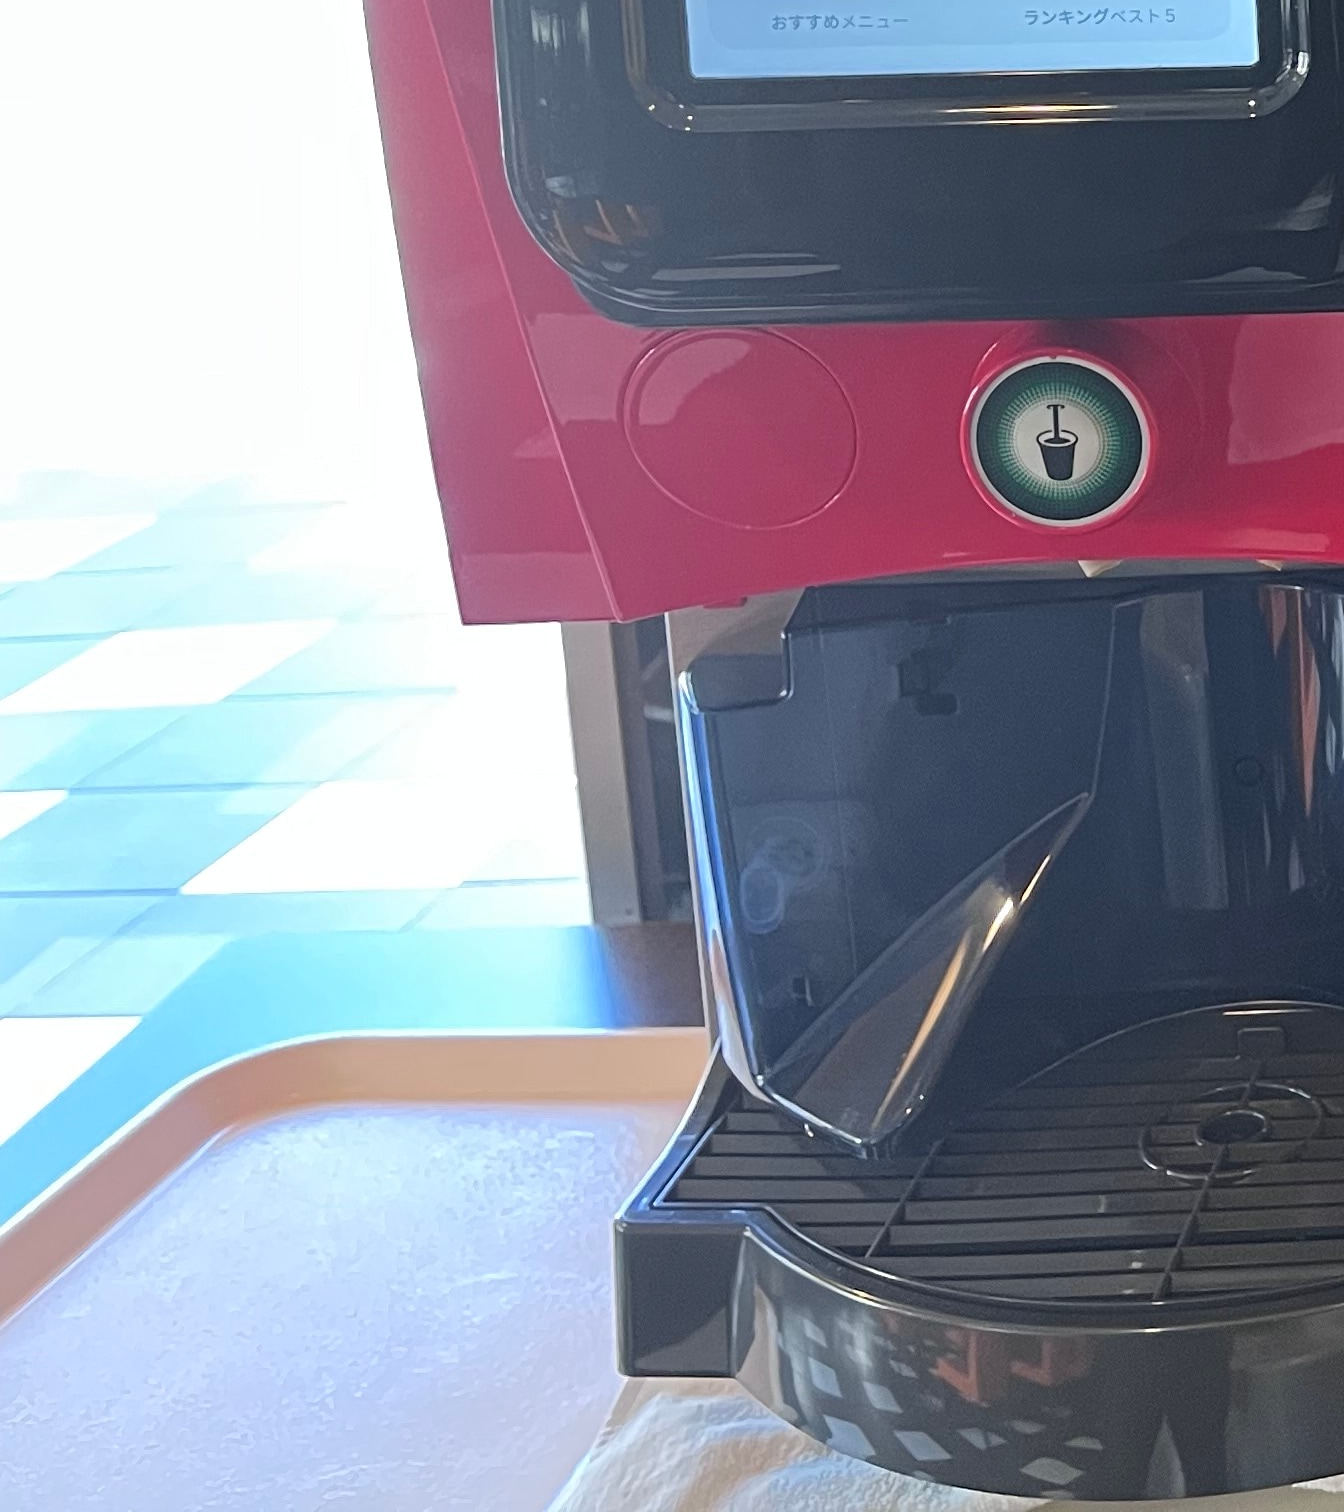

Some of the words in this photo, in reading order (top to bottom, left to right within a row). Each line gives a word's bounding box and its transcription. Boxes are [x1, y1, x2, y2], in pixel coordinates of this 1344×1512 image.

[771, 12, 909, 32] おすすめメニュー
